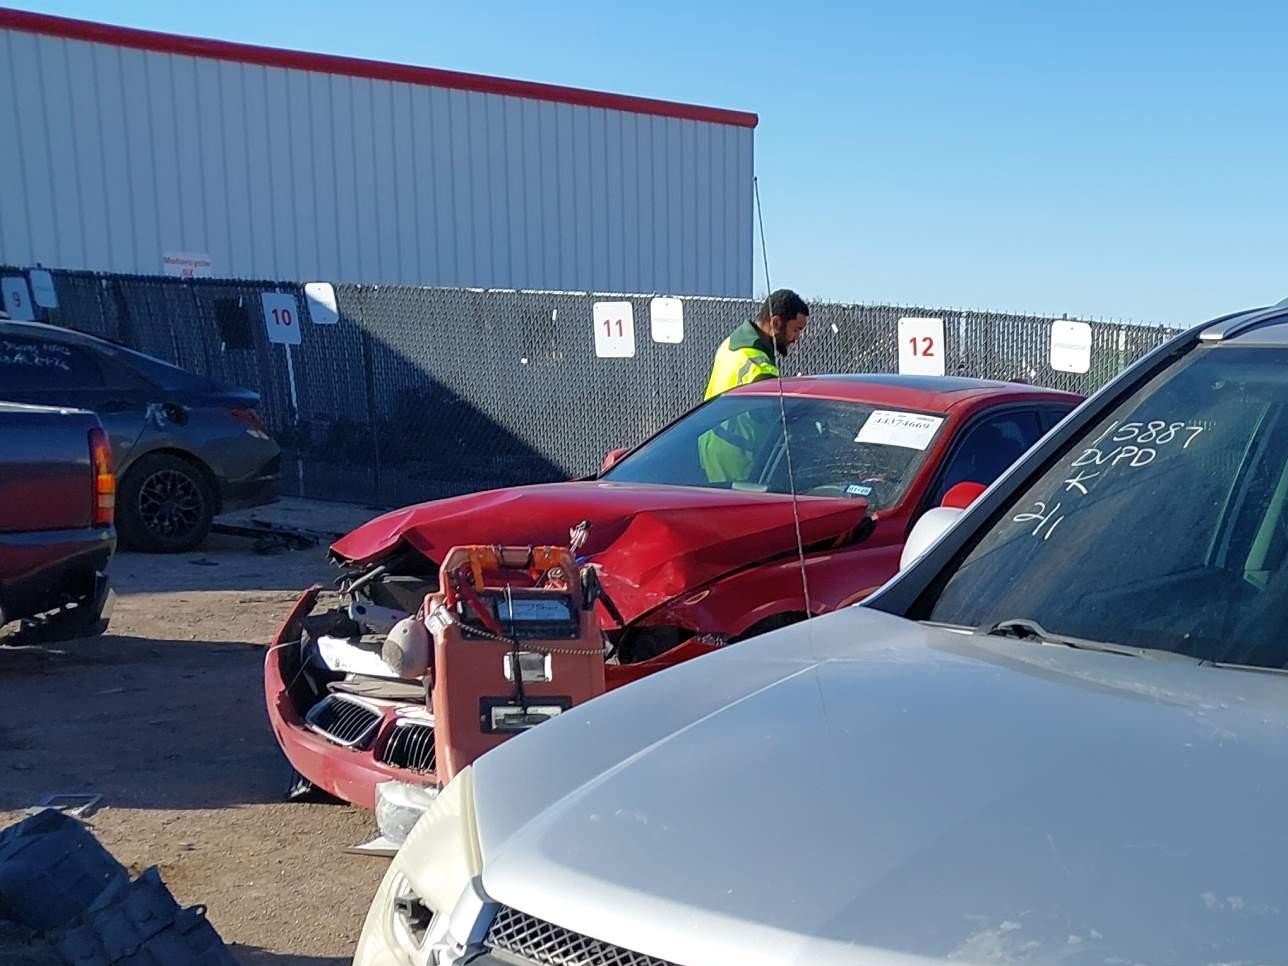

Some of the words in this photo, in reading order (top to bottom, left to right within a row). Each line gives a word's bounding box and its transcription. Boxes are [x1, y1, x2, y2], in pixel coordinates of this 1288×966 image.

[271, 308, 292, 326] 10
[603, 319, 623, 337] 11
[909, 336, 935, 357] 12
